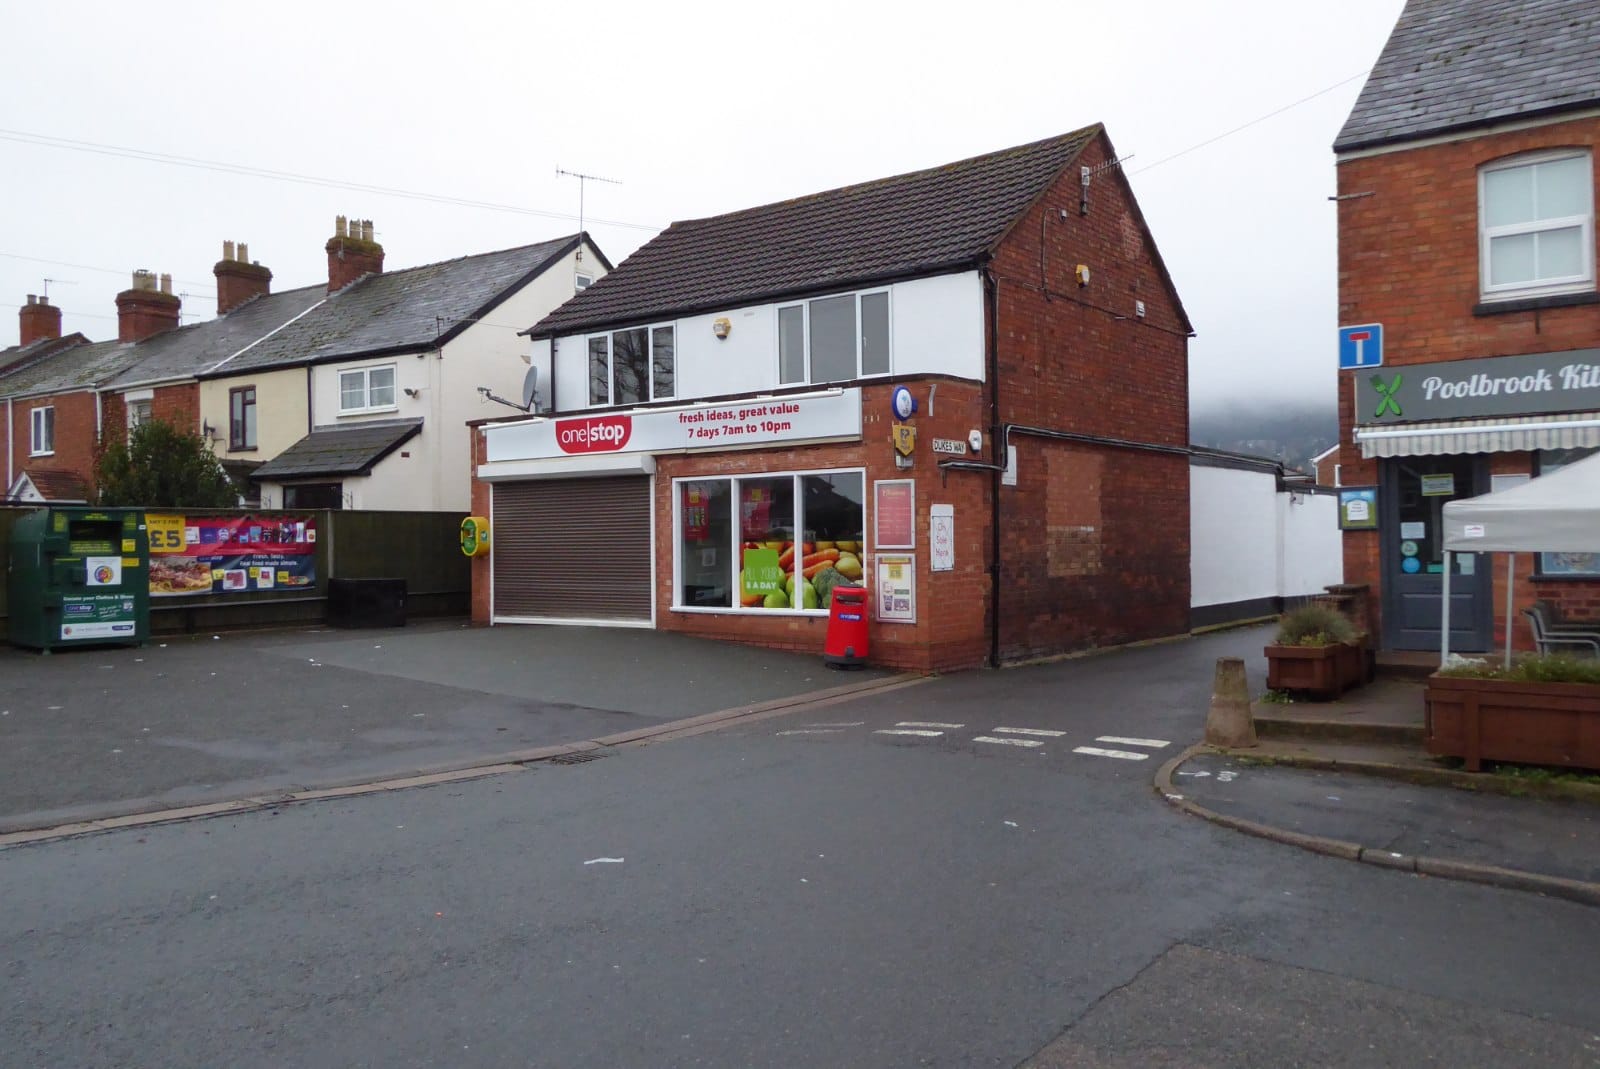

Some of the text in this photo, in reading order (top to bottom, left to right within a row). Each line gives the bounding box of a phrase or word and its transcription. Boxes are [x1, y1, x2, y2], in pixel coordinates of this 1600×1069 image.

[1422, 369, 1552, 400] Poolbrook
[679, 402, 800, 424] fresh ideas, great value
[590, 424, 624, 445] stop
[688, 420, 791, 438] 7 days 7am to 10pm
[934, 440, 965, 452] DUKES WAY
[150, 530, 181, 548] £5
